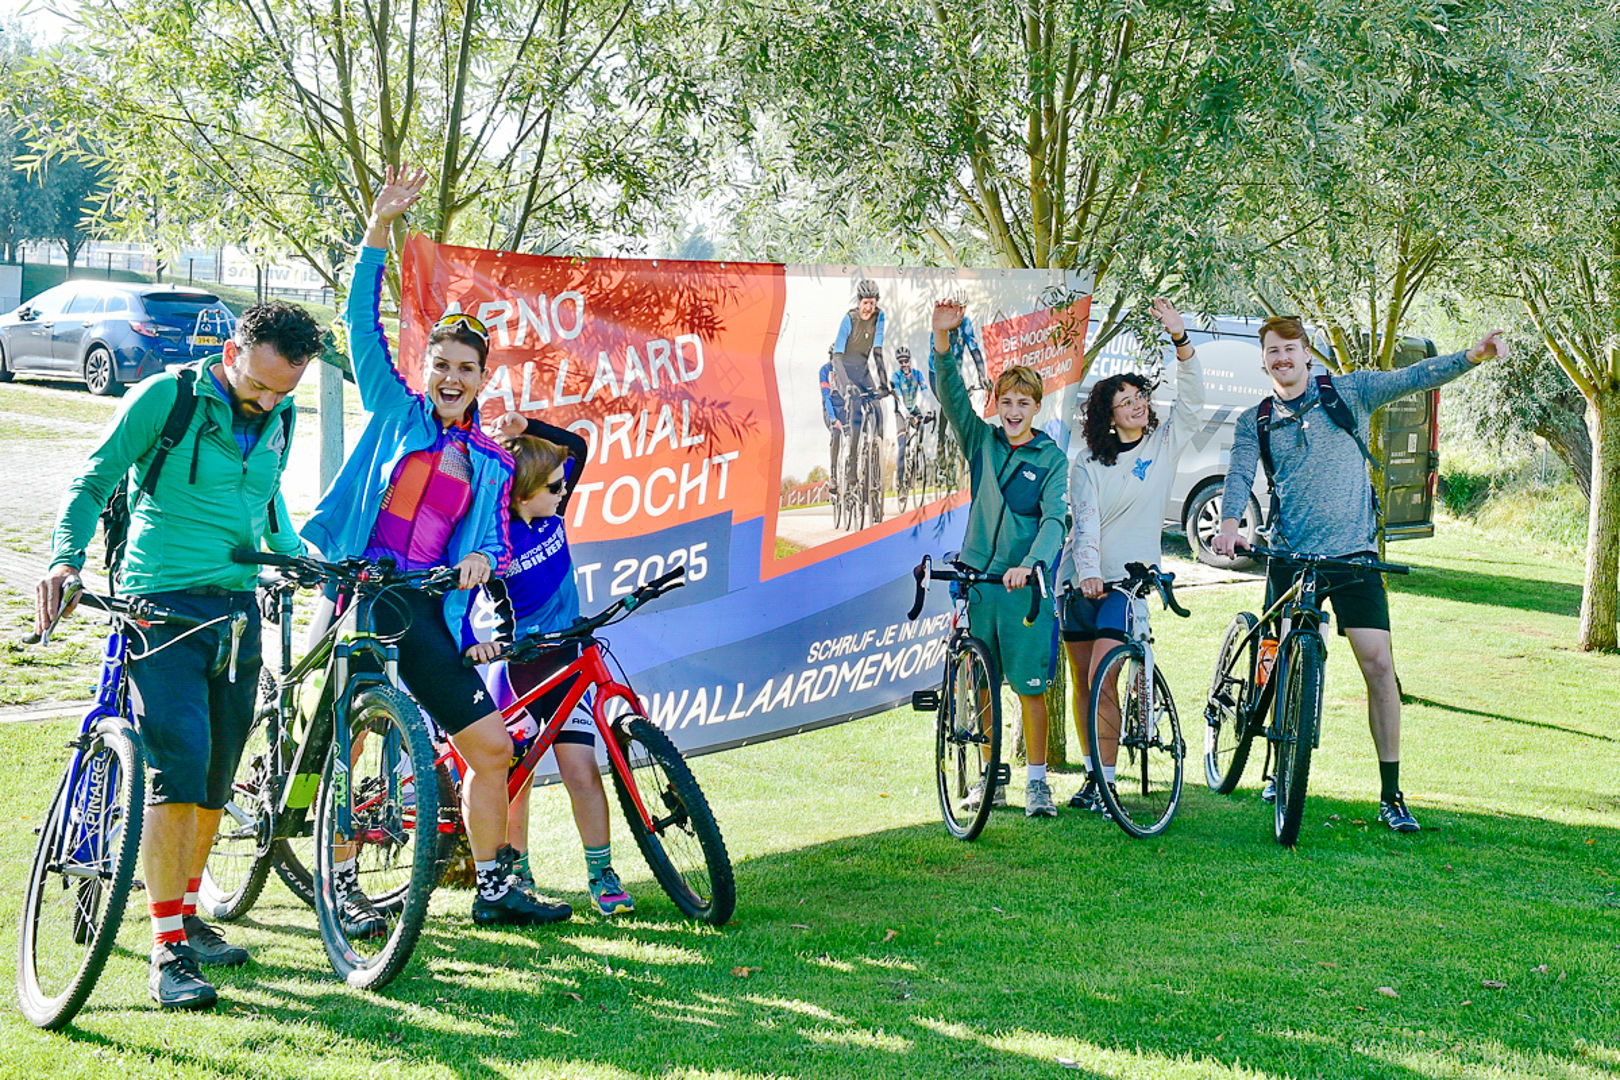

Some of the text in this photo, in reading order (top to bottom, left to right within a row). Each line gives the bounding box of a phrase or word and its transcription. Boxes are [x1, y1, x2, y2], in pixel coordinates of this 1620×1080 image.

[1003, 323, 1063, 353] DE MOOIST
[478, 333, 704, 412] ALLAARD
[566, 399, 705, 465] ORIAL
[573, 451, 739, 528] TOCHT
[610, 542, 708, 596] 2025
[807, 629, 877, 664] SCHRIJF
[876, 624, 899, 648] JE
[898, 620, 920, 642] IN!
[571, 717, 593, 726] AGU
[86, 750, 106, 825] PINAREL
[334, 771, 348, 808] FOX
[280, 861, 314, 898] ENDA
